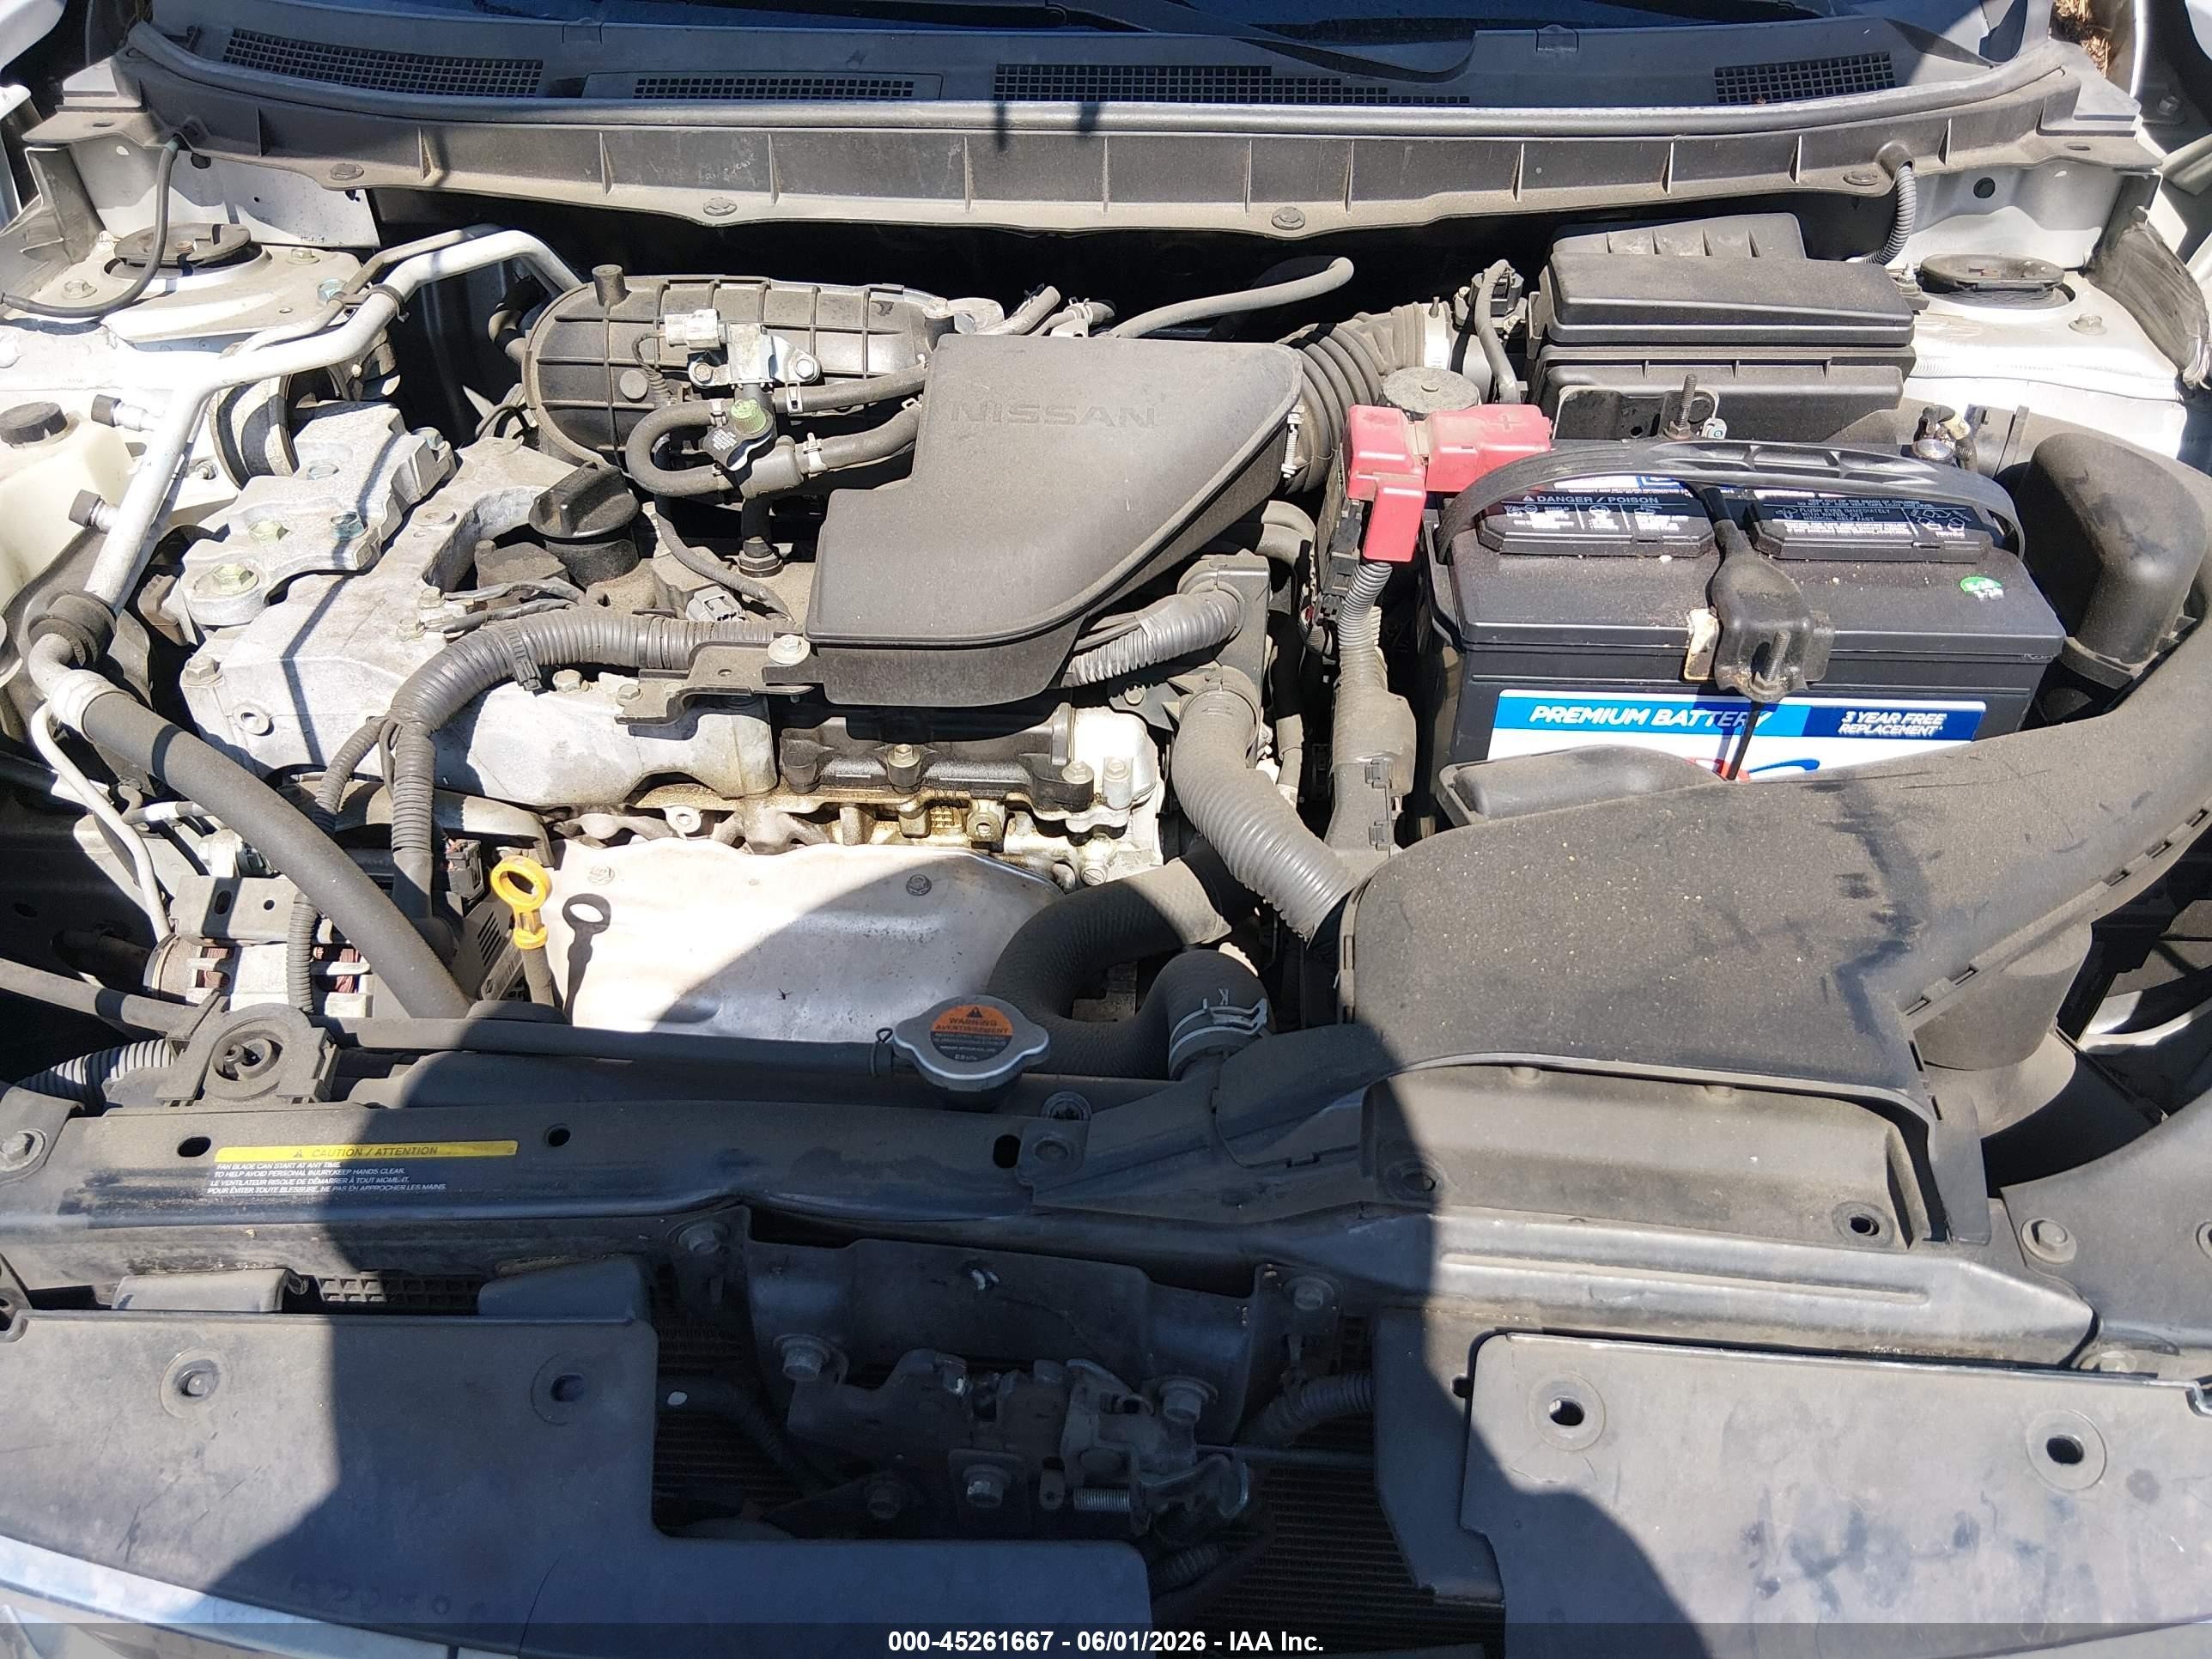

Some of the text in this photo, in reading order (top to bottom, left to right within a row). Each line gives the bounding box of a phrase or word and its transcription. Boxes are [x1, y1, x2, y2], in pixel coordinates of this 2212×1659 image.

[949, 403, 1156, 428] NISSAN
[1529, 705, 1773, 727] PREMIUM BATTERY
[1840, 711, 1948, 726] 3 YEAR FREE
[949, 1017, 998, 1027] WARNING
[312, 1146, 439, 1158] CAUTION / ATTENTION
[307, 1176, 348, 1185] DÉMARRER
[229, 1185, 255, 1194] ÉVITER
